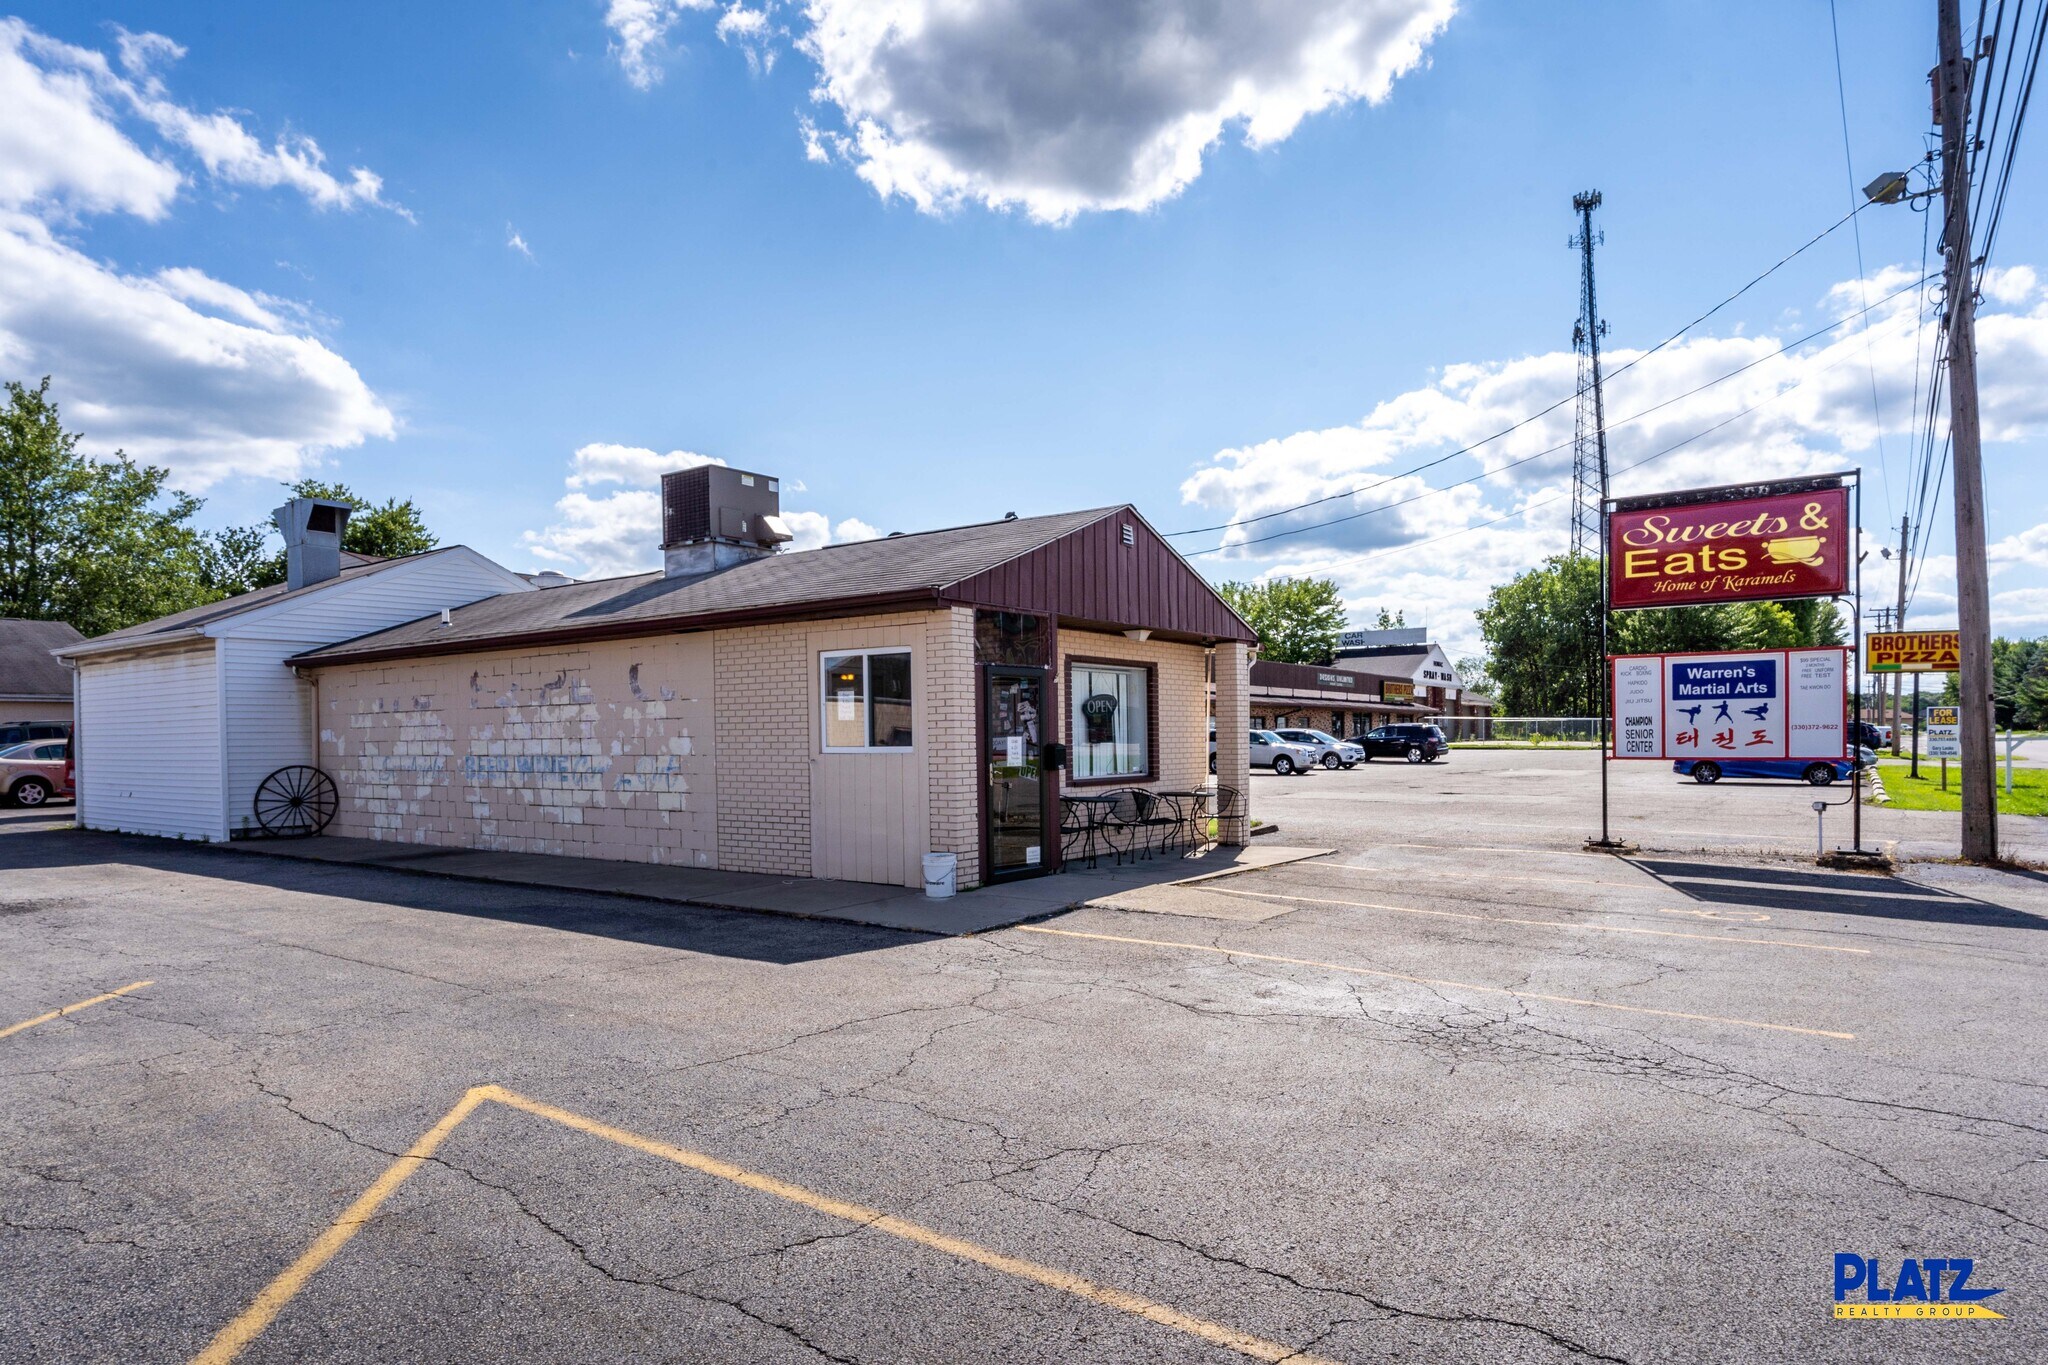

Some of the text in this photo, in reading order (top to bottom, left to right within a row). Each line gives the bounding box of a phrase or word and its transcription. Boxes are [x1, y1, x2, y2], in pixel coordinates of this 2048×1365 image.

[1622, 502, 1829, 546] Sweets &
[1624, 544, 1748, 578] Eats
[1652, 569, 1797, 593] Home of Karamels
[1876, 651, 1958, 663] PIZZA
[1686, 666, 1756, 680] Warren's
[1678, 682, 1768, 696] Martial Arts
[1086, 699, 1113, 714] OPEN
[1933, 709, 1953, 717] FOR
[1625, 716, 1653, 726] CHAMPION
[1929, 716, 1957, 724] LEASE
[1625, 729, 1654, 740] SENIOR
[1626, 741, 1653, 752] CENTER
